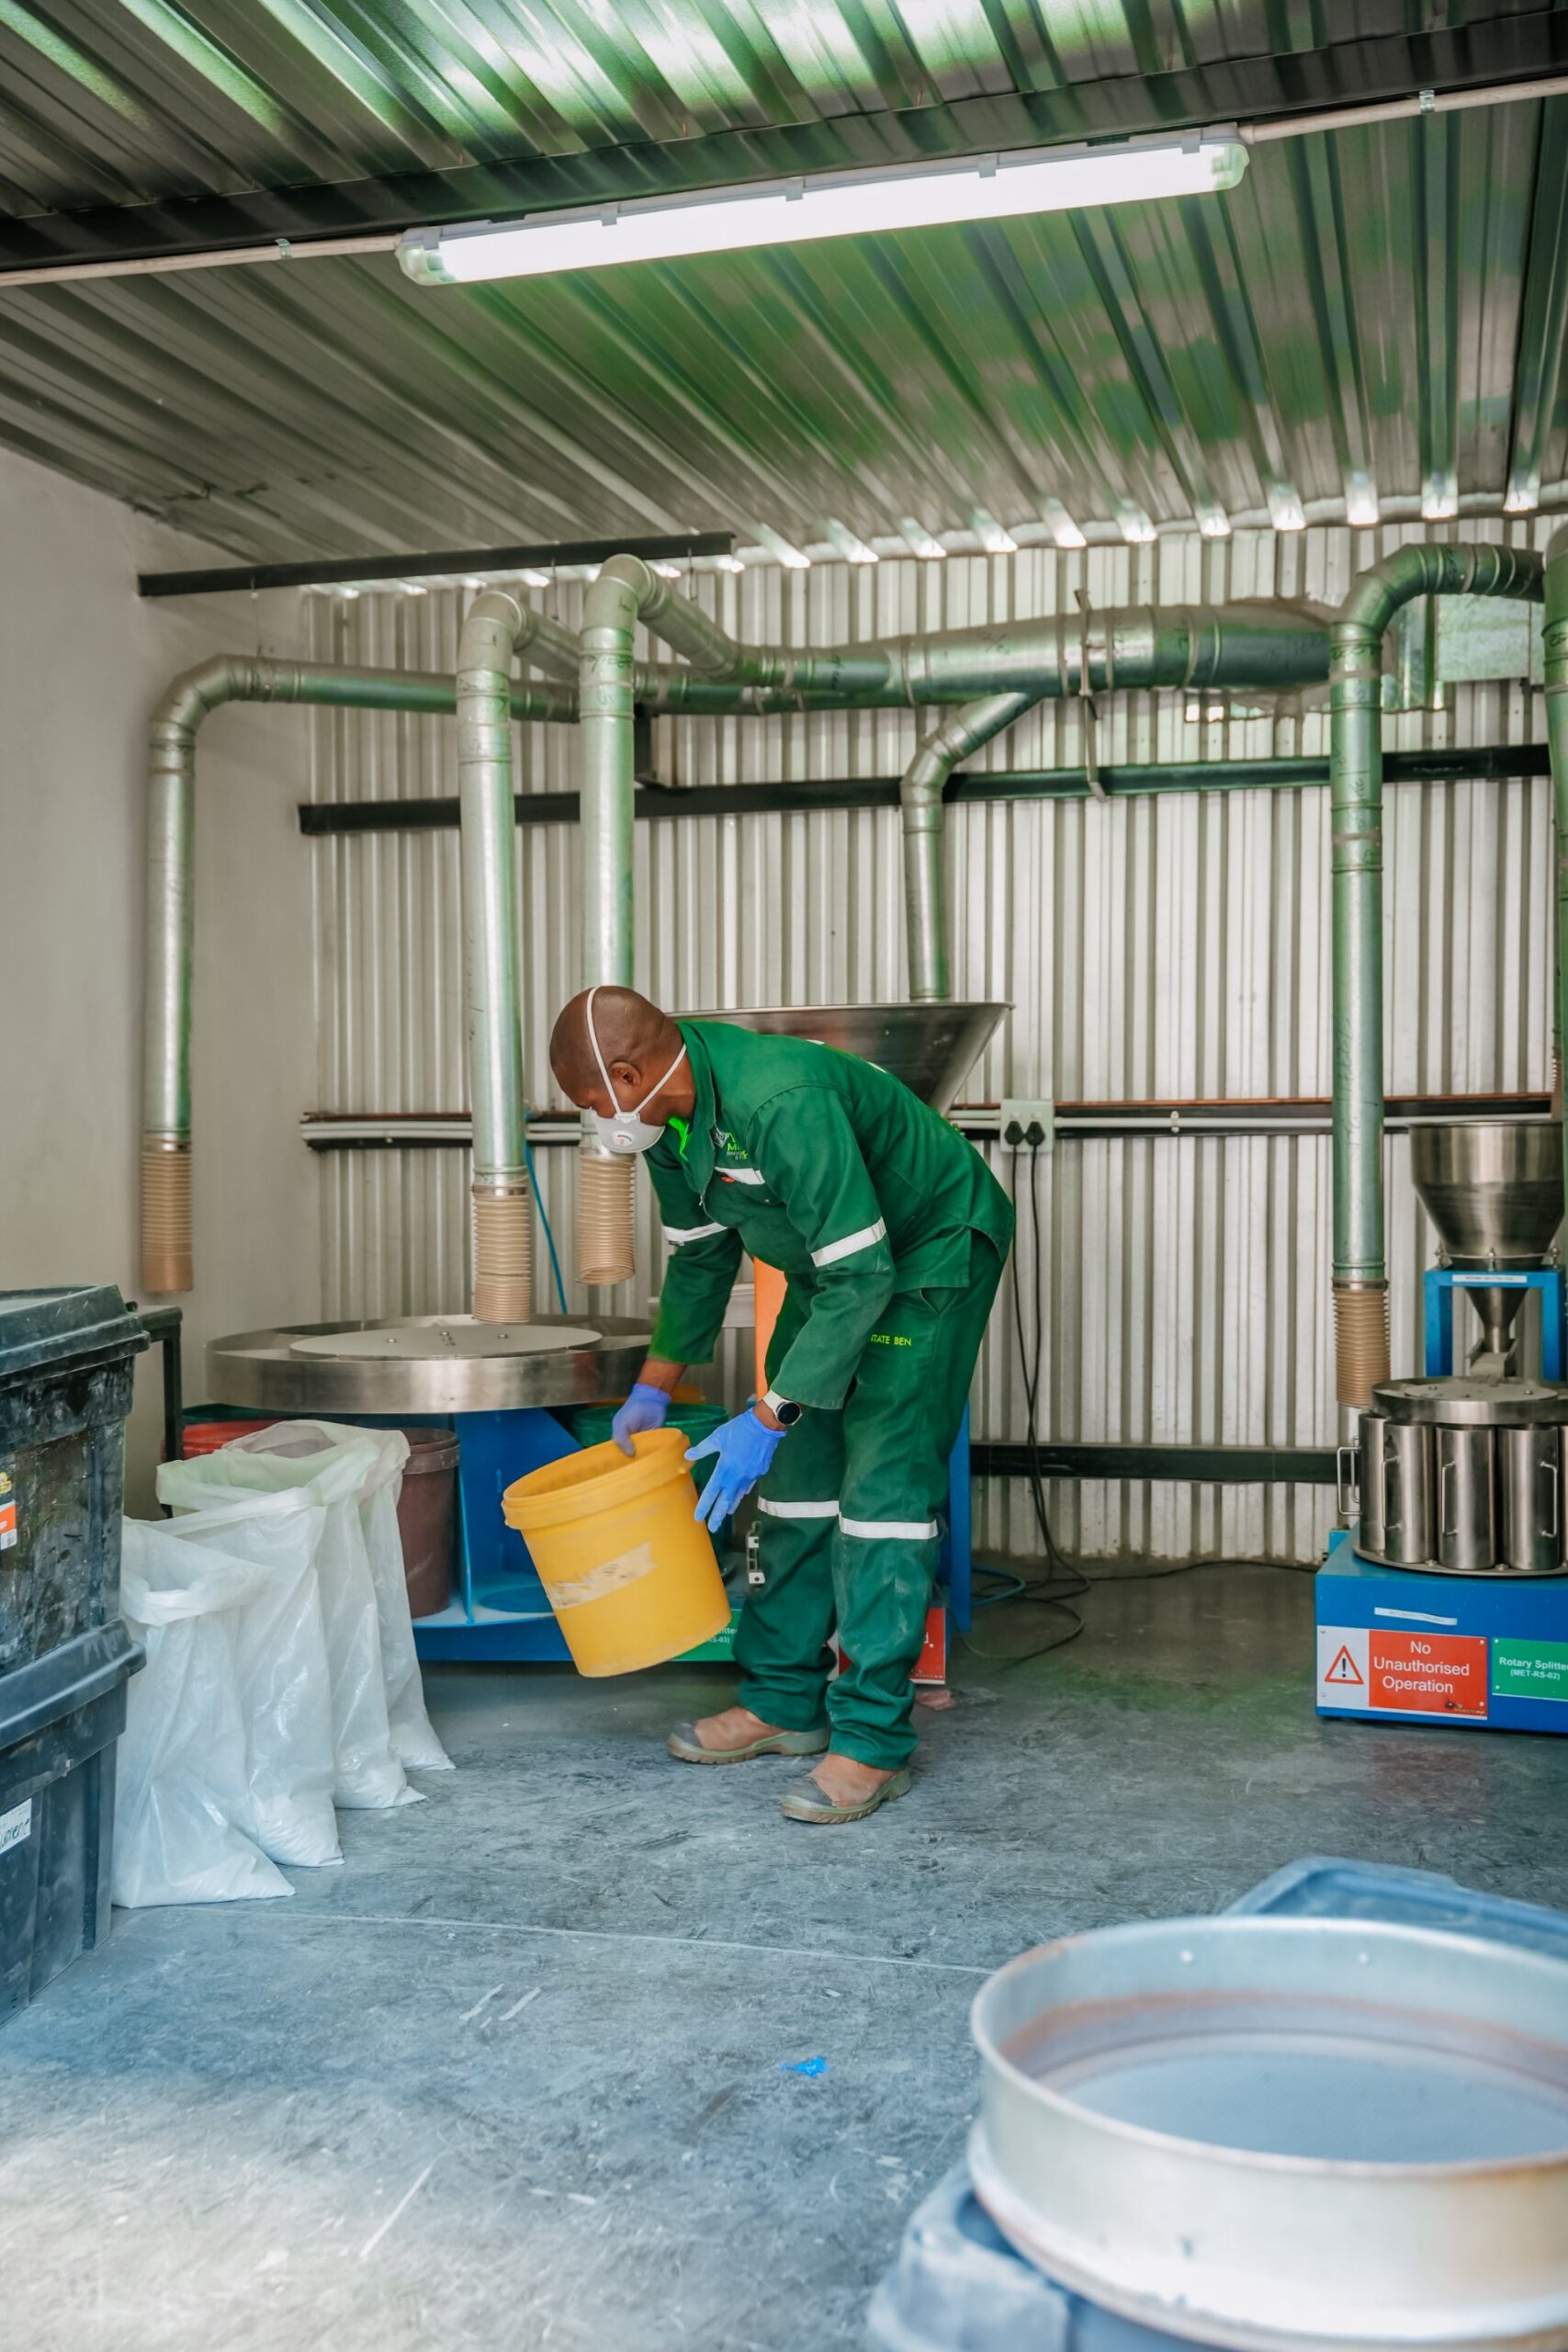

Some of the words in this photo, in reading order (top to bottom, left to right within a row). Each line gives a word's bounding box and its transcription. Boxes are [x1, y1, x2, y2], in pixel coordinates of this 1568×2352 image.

[894, 1336, 912, 1347] BEN
[1410, 1640, 1431, 1655] No
[1373, 1656, 1470, 1676] Unauthorised
[1498, 1657, 1532, 1669] Rotary
[1510, 1668, 1561, 1680] (MET-RS-02)
[1382, 1675, 1454, 1694] Operation
